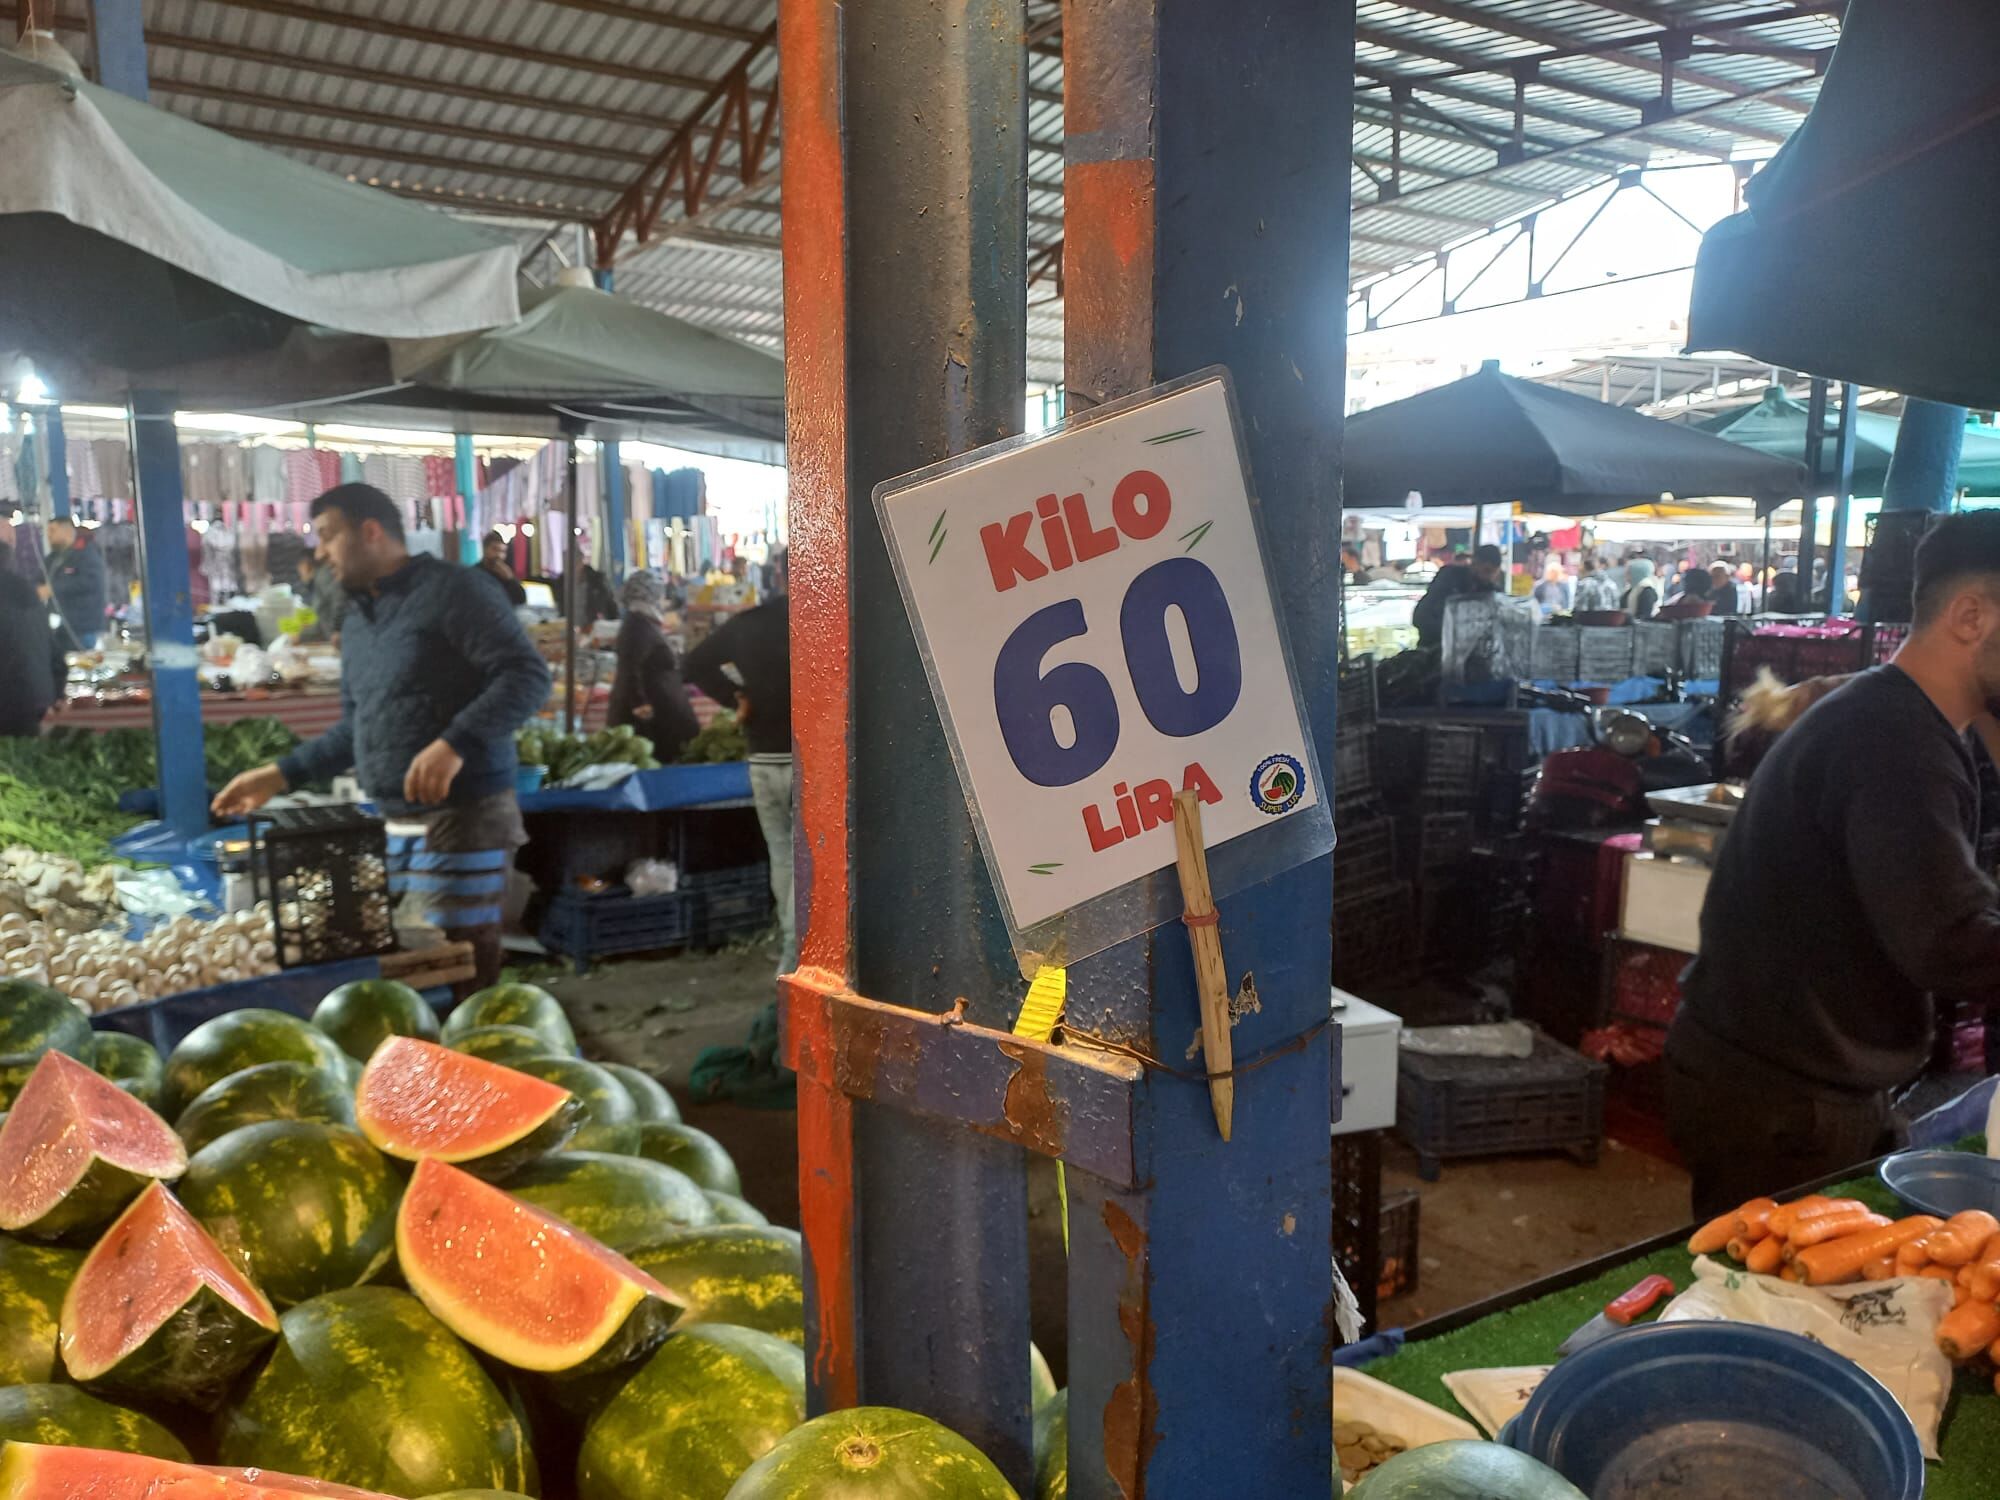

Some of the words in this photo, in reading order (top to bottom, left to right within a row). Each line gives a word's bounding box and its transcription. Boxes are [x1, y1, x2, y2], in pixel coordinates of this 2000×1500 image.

[994, 557, 1242, 787] 60
[1260, 801, 1283, 812] SUPER
[1286, 792, 1301, 808] LUX
